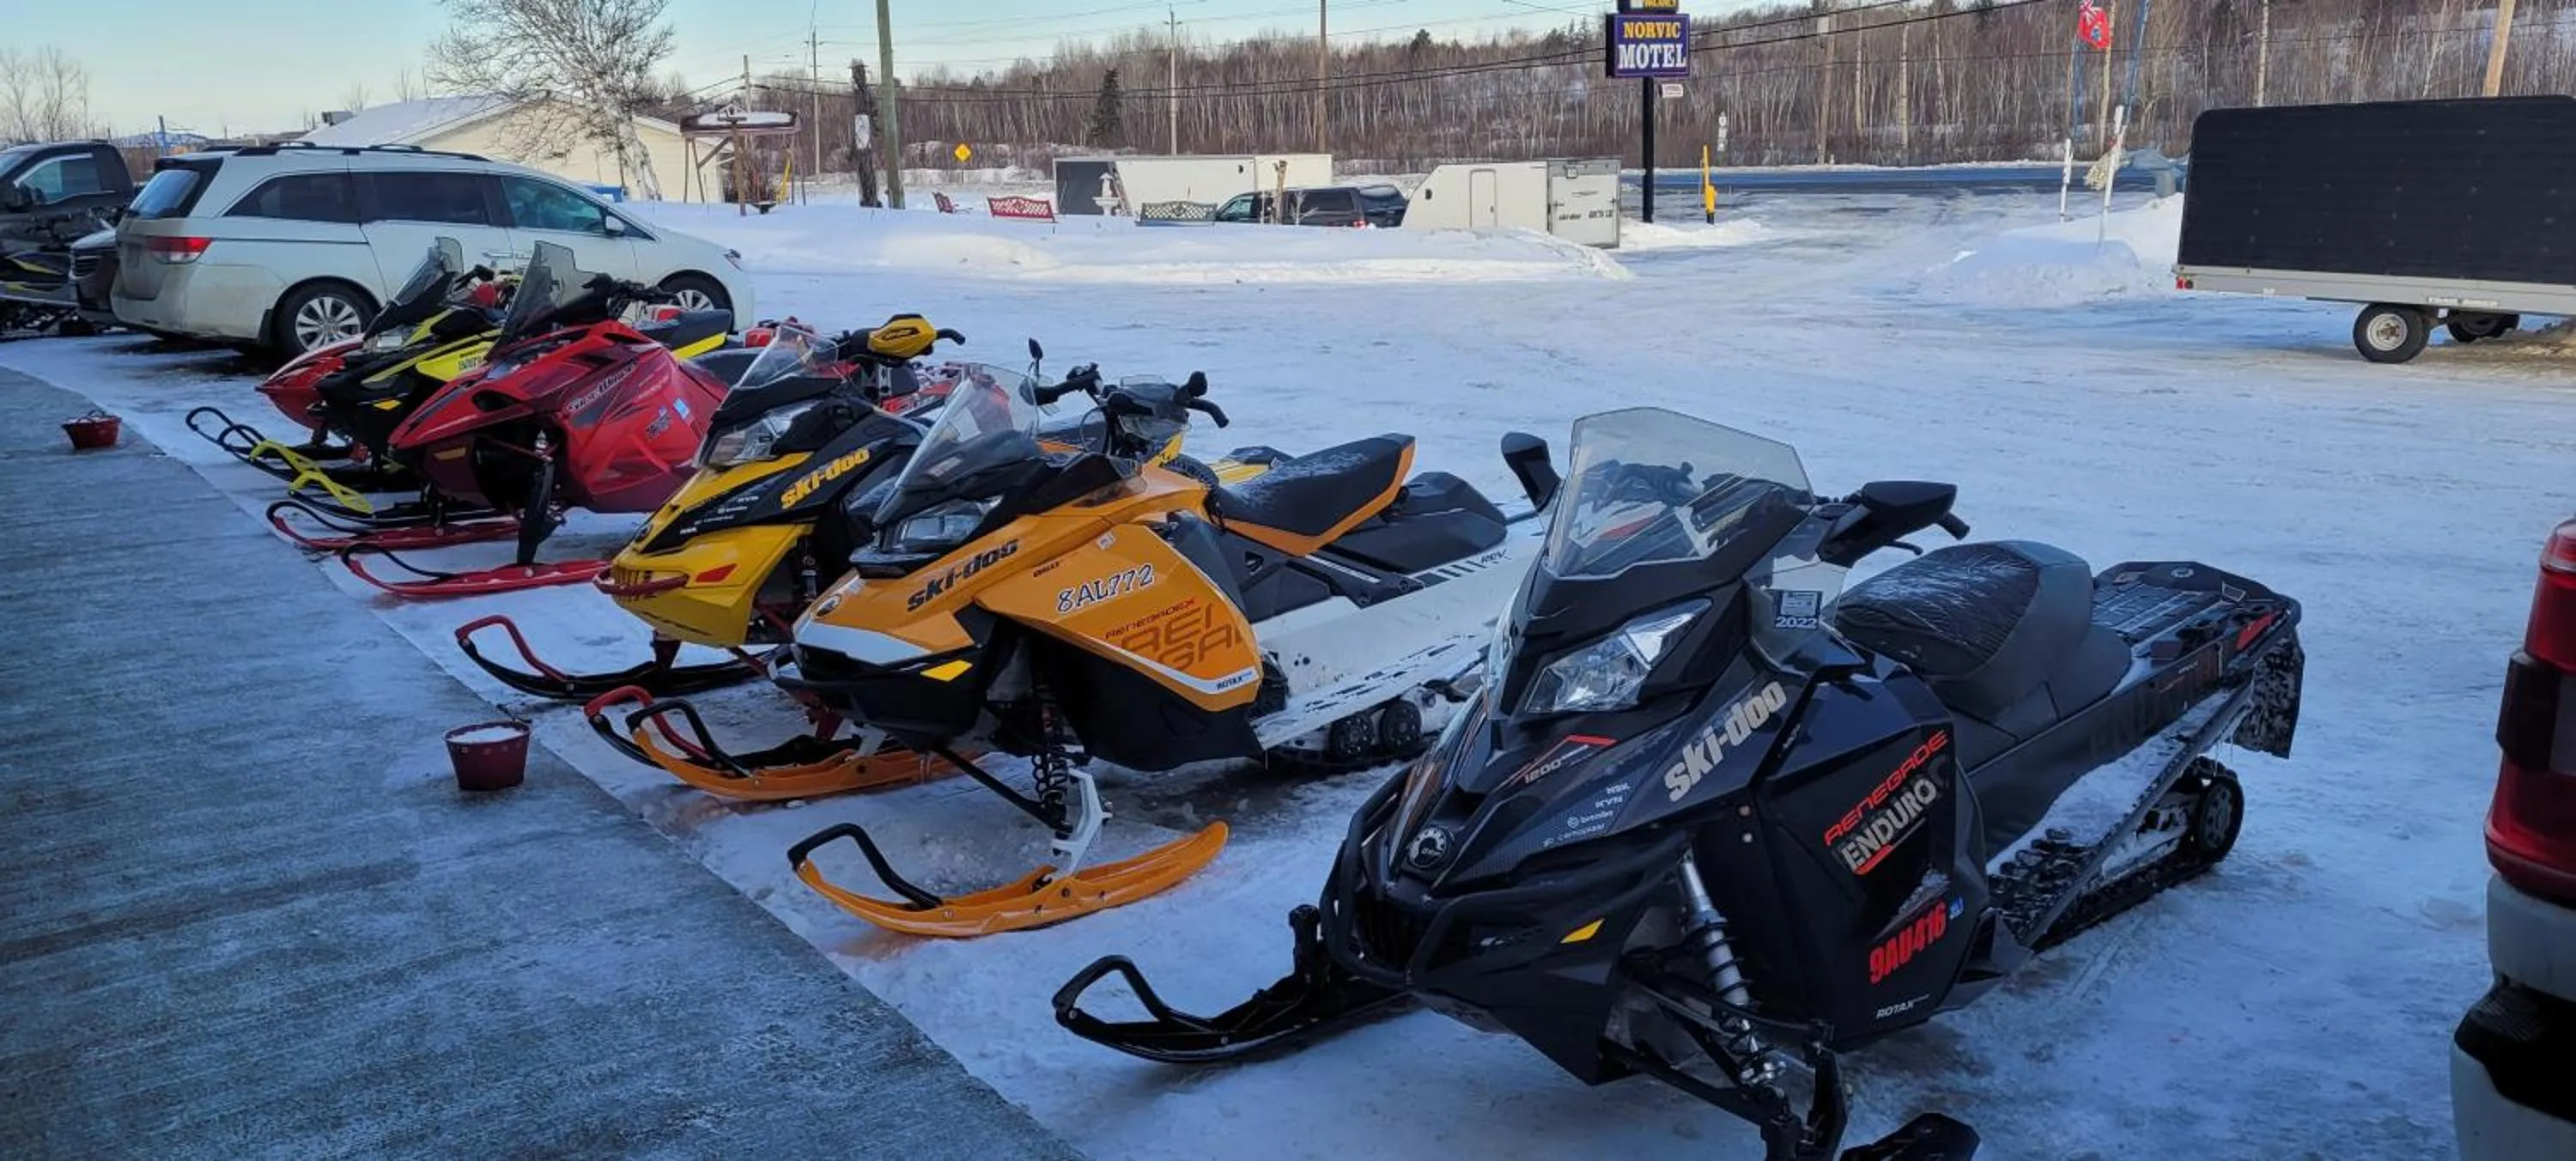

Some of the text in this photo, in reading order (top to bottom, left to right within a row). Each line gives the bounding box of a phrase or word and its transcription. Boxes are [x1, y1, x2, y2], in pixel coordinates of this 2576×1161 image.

[1623, 21, 1680, 39] NORVIC
[1617, 43, 1686, 69] MOTEL
[1057, 563, 1154, 614] 8AL772
[1775, 616, 1818, 629] 2022
[1524, 759, 1562, 784] 1200
[1824, 729, 1949, 846] RENEGADE
[1841, 778, 1937, 872] ENDURO
[1869, 901, 1947, 984] 9AU416
[1875, 1000, 1914, 1019] ROTAX
